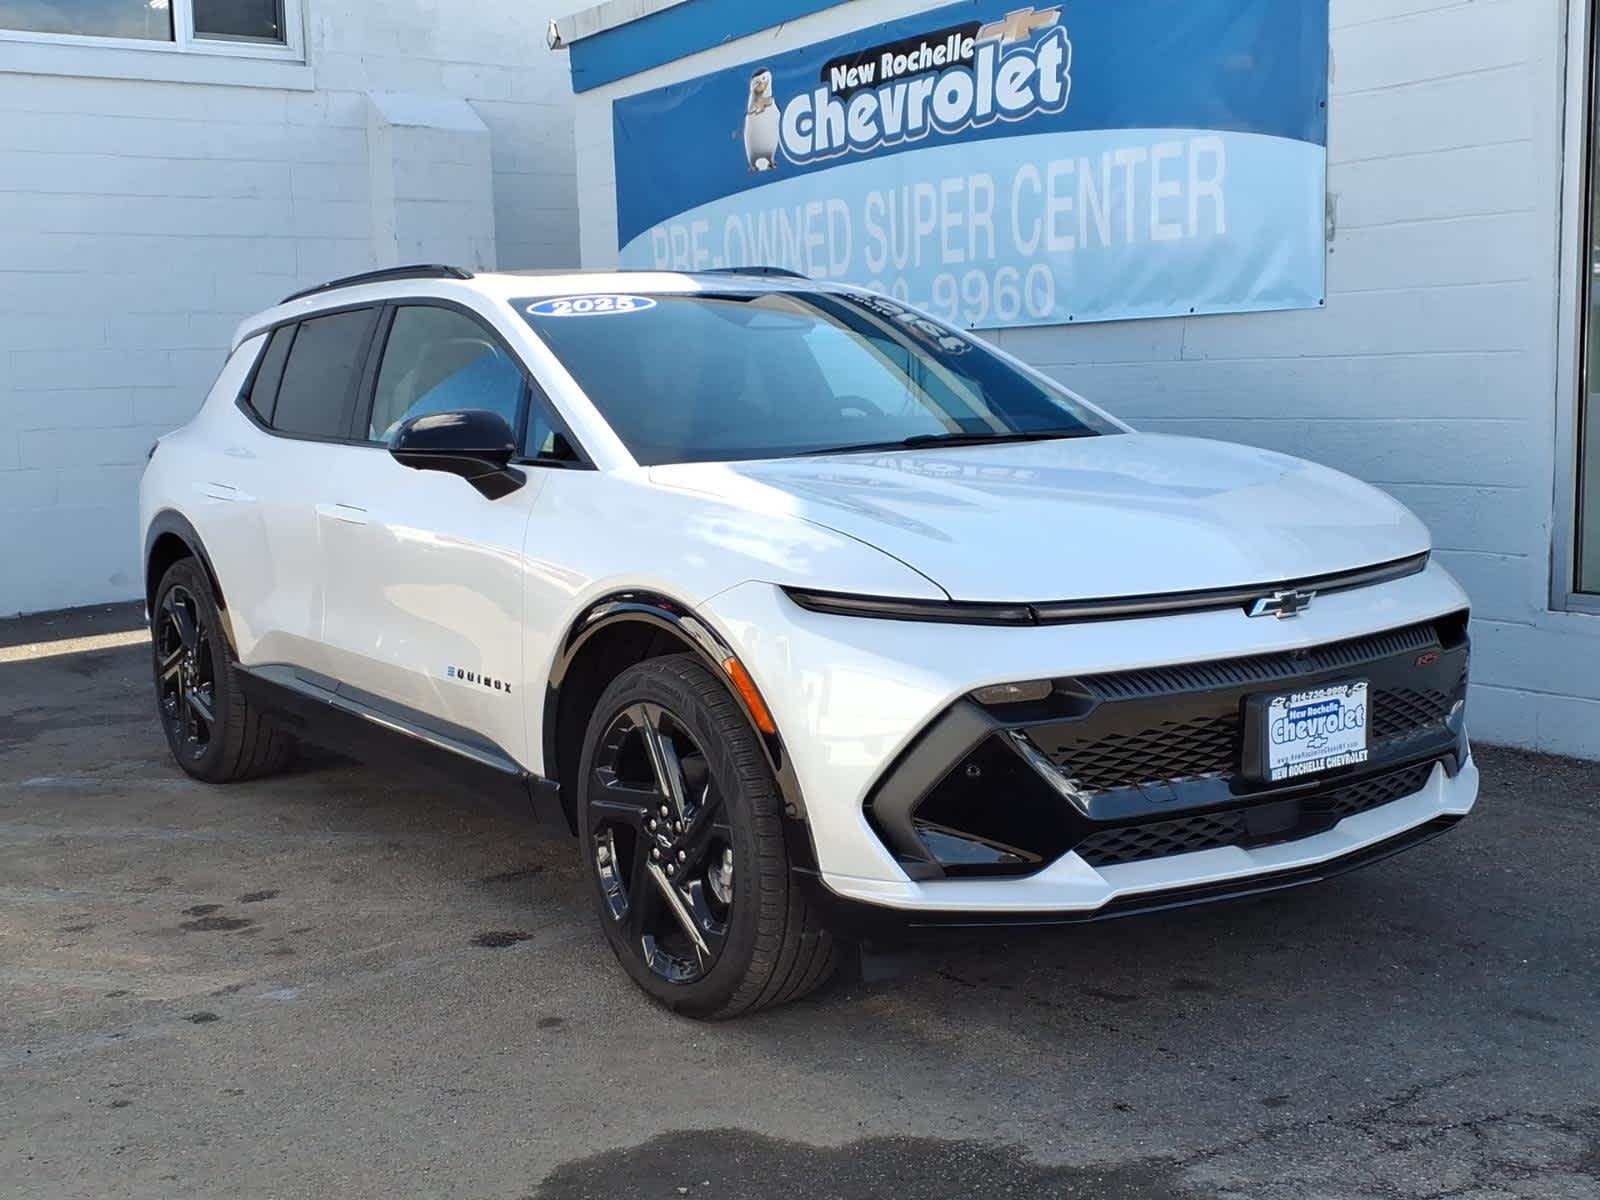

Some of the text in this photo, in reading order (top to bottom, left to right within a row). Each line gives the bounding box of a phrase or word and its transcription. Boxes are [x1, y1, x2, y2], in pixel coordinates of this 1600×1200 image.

[831, 33, 975, 92] New Rochelle
[781, 35, 1064, 156] Chevrolet
[651, 135, 1226, 277] PRE-OWNED SUPER CENTER
[552, 296, 635, 314] 2025
[447, 666, 511, 694] EQUINOX
[1271, 703, 1365, 745] Chevrolet
[1289, 702, 1338, 721] New Rochelle
[1272, 750, 1368, 781] NEW ROCHELLE CHEVROLET
